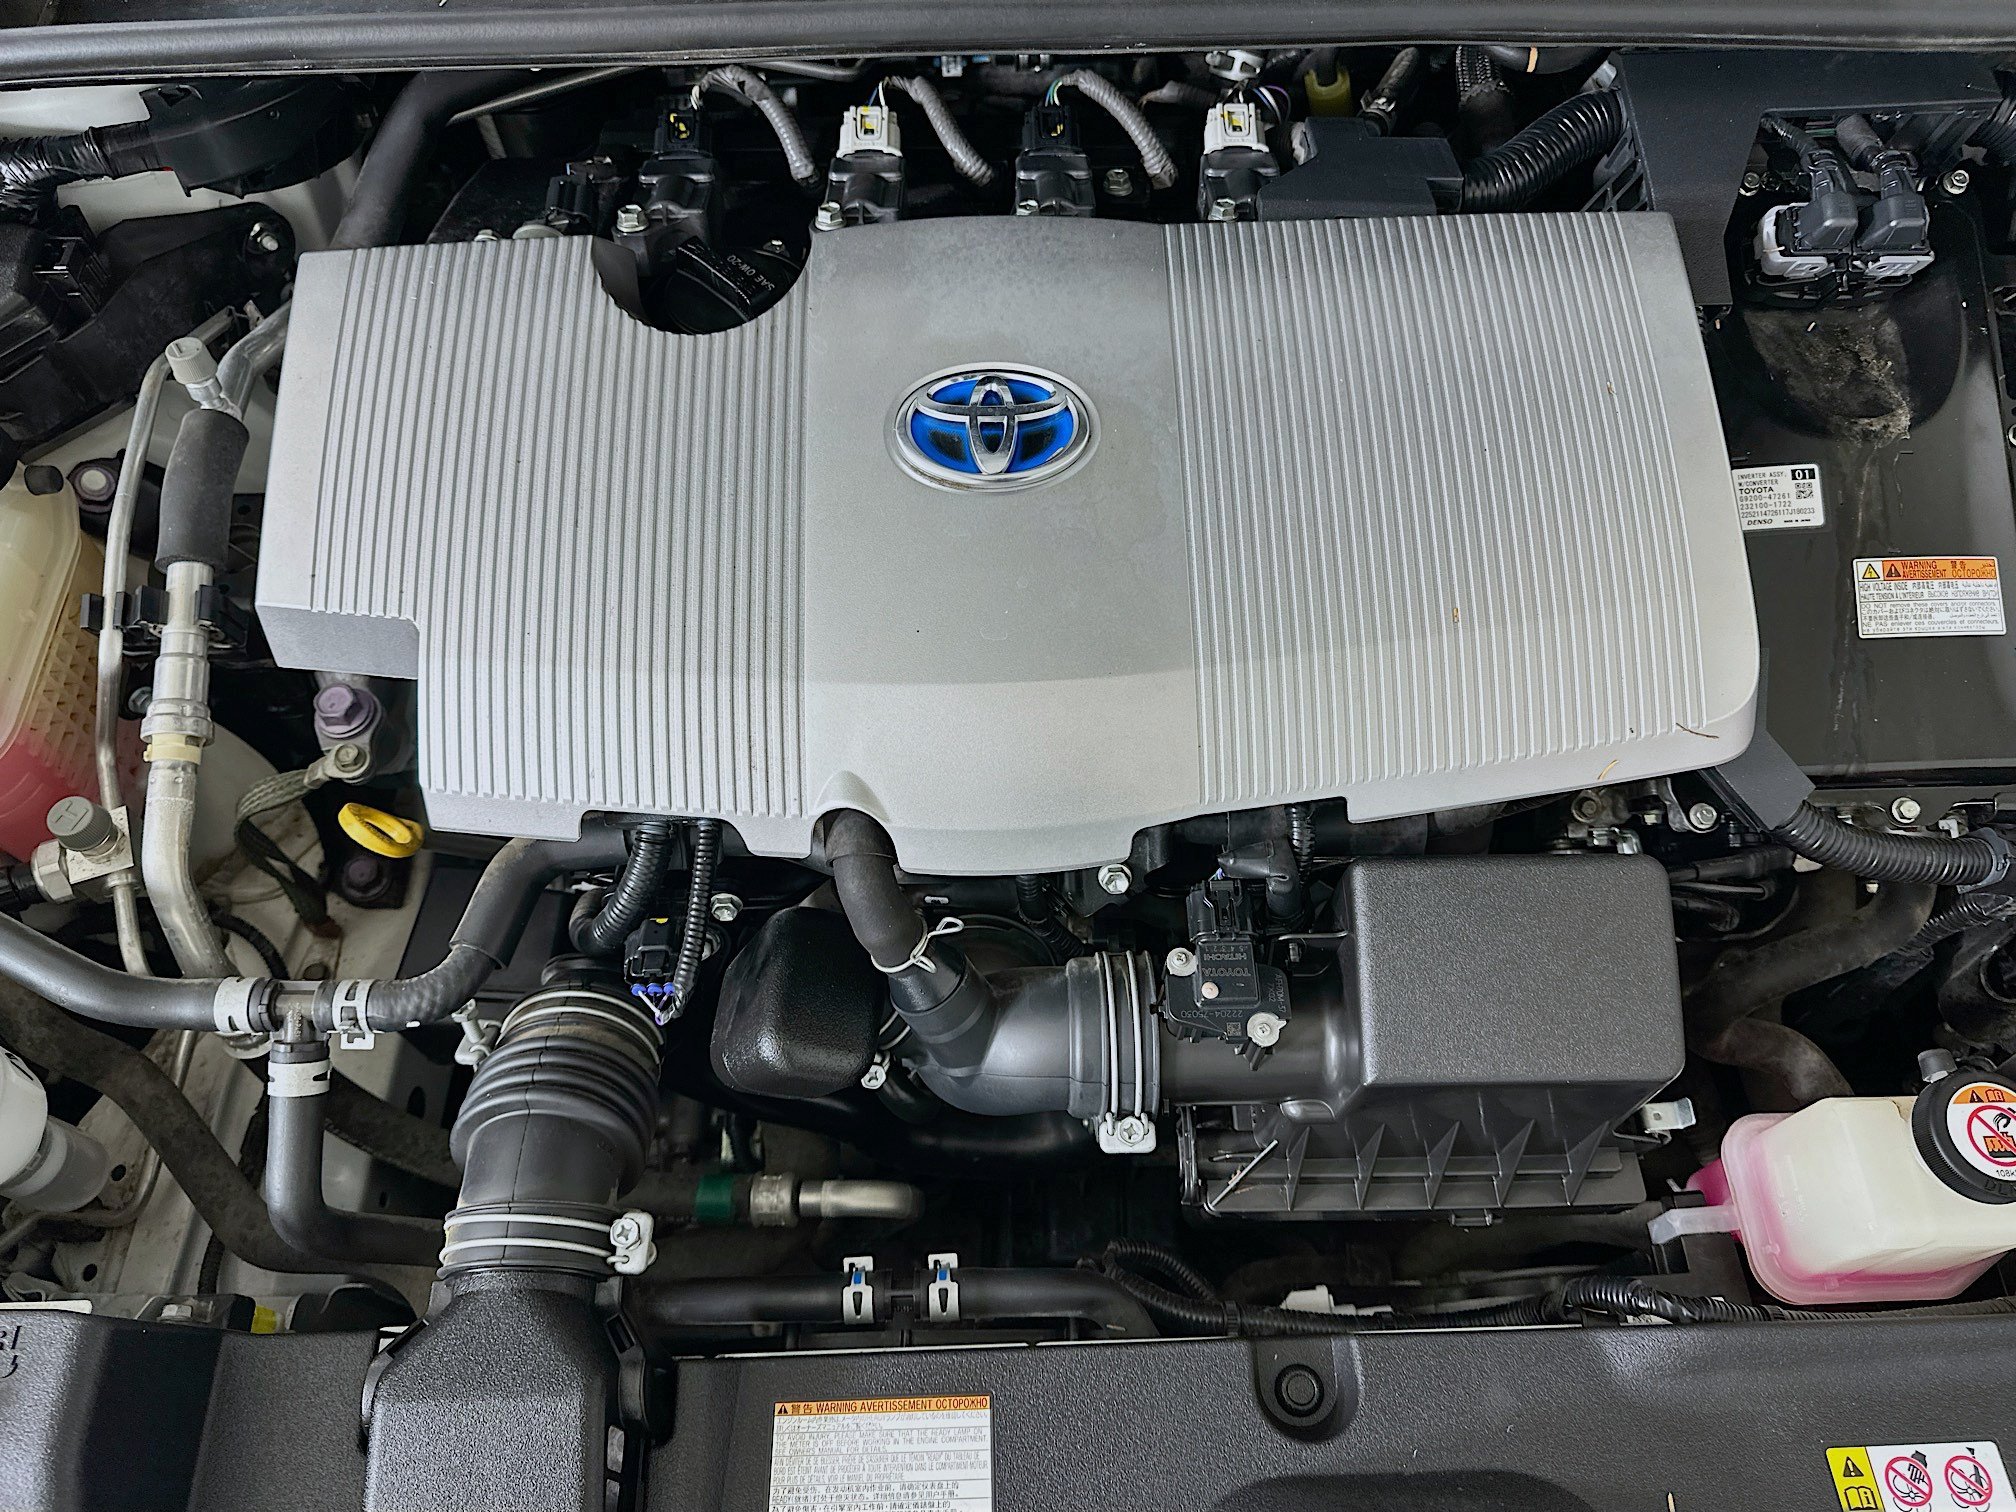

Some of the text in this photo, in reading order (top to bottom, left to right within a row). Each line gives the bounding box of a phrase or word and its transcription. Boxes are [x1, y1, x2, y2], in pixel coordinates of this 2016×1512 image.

[727, 255, 755, 276] 0W-20
[756, 275, 775, 290] SAE
[1795, 470, 1809, 479] 01
[1738, 479, 1778, 487] W/CONVERTER
[1740, 501, 1791, 510] 232100-1722
[1901, 561, 1937, 570] WARNING
[1902, 569, 1946, 578] AVERTISSEMENT
[1202, 967, 1251, 976] TOYOTA
[816, 1400, 932, 1413] WARNING AVERTISSEMENT
[935, 1397, 988, 1409] ОСТОРОЖНО
[791, 1404, 812, 1415] 警告
[879, 1430, 895, 1438] SURE
[915, 1462, 927, 1470] DANS
